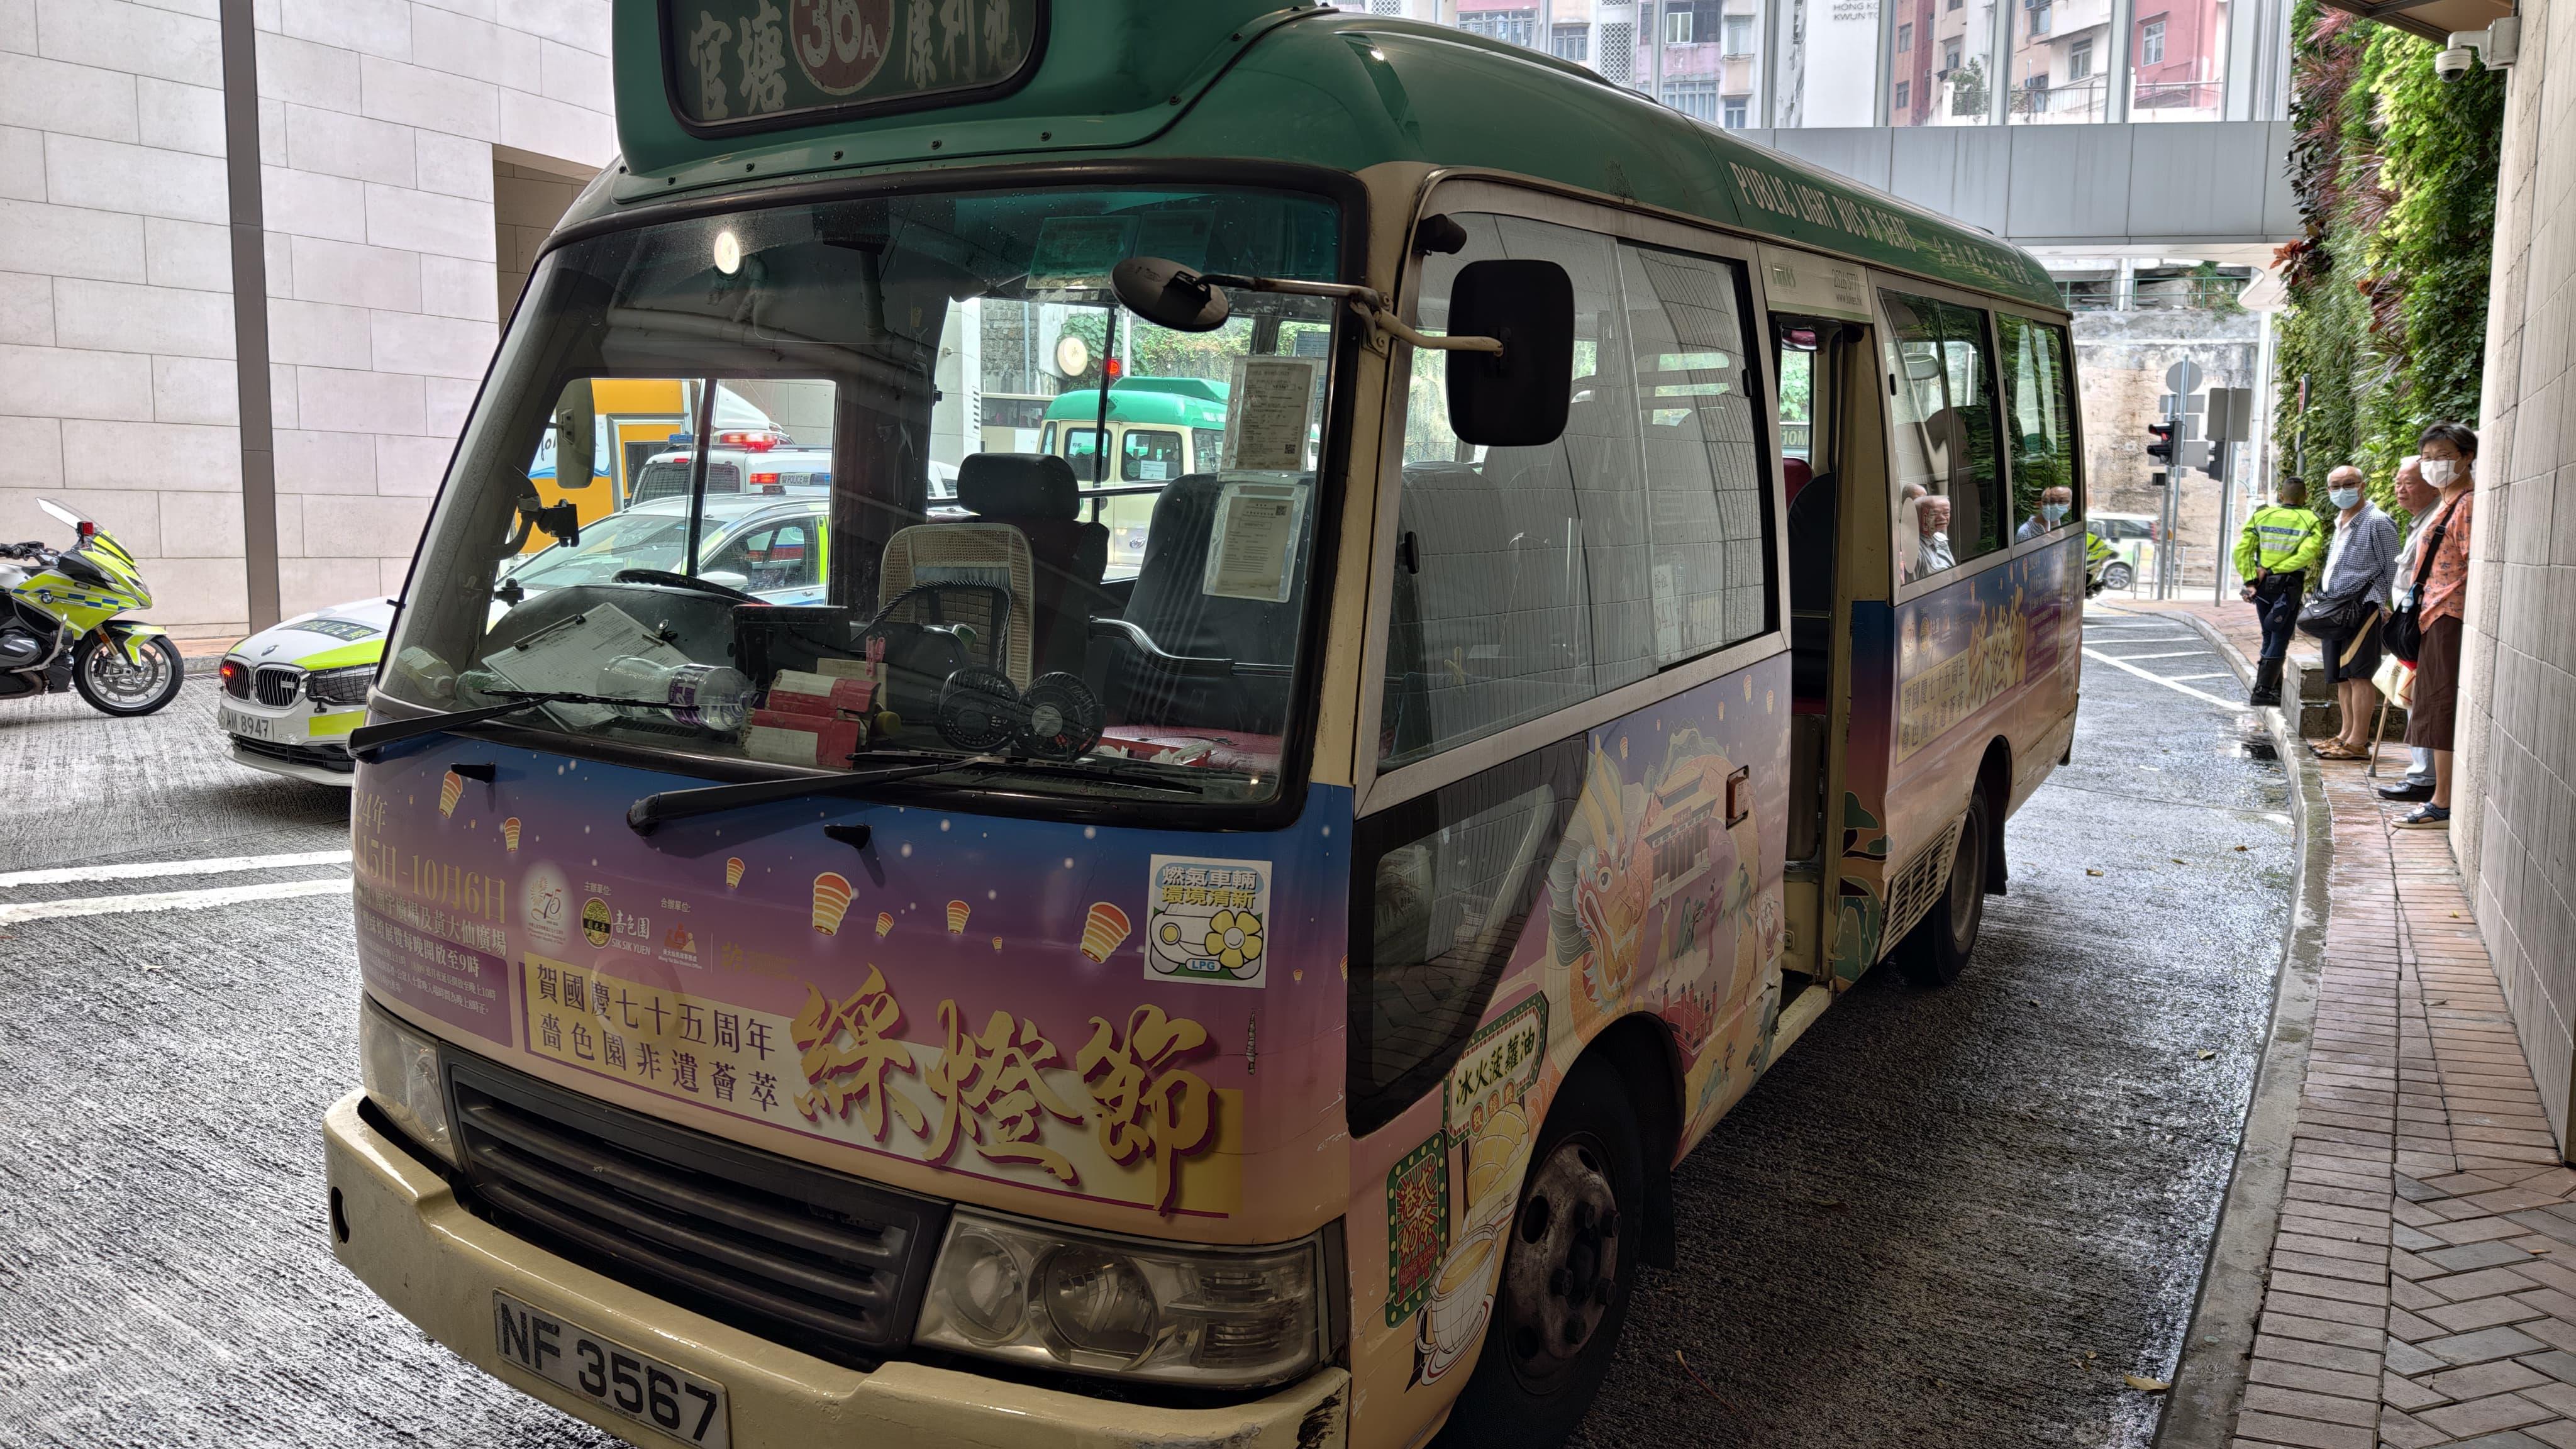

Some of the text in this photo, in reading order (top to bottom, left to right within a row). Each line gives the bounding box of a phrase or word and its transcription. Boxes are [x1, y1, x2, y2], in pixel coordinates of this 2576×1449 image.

[1833, 3, 1864, 11] HONG
[1833, 13, 1865, 21] KWUN
[798, 0, 881, 69] 36A
[1729, 161, 1917, 253] PUBLIC LIGHT BUS 16 SEATS
[226, 711, 269, 738] AM 8947
[1162, 865, 1257, 890] 燃氣車輛
[1162, 886, 1256, 909] 環境清新
[612, 937, 651, 957] SIK SIK YUEN
[1192, 960, 1215, 970] LPG
[537, 963, 775, 1061] 賀國慶七十五周年
[540, 1013, 779, 1113] 嗇色園非遺薈萃
[1457, 1026, 1535, 1106] 冰火菠蘿油
[790, 962, 1219, 1216] 綵燈節
[1419, 1244, 1436, 1265] KONG
[501, 1302, 718, 1441] NF 3567
